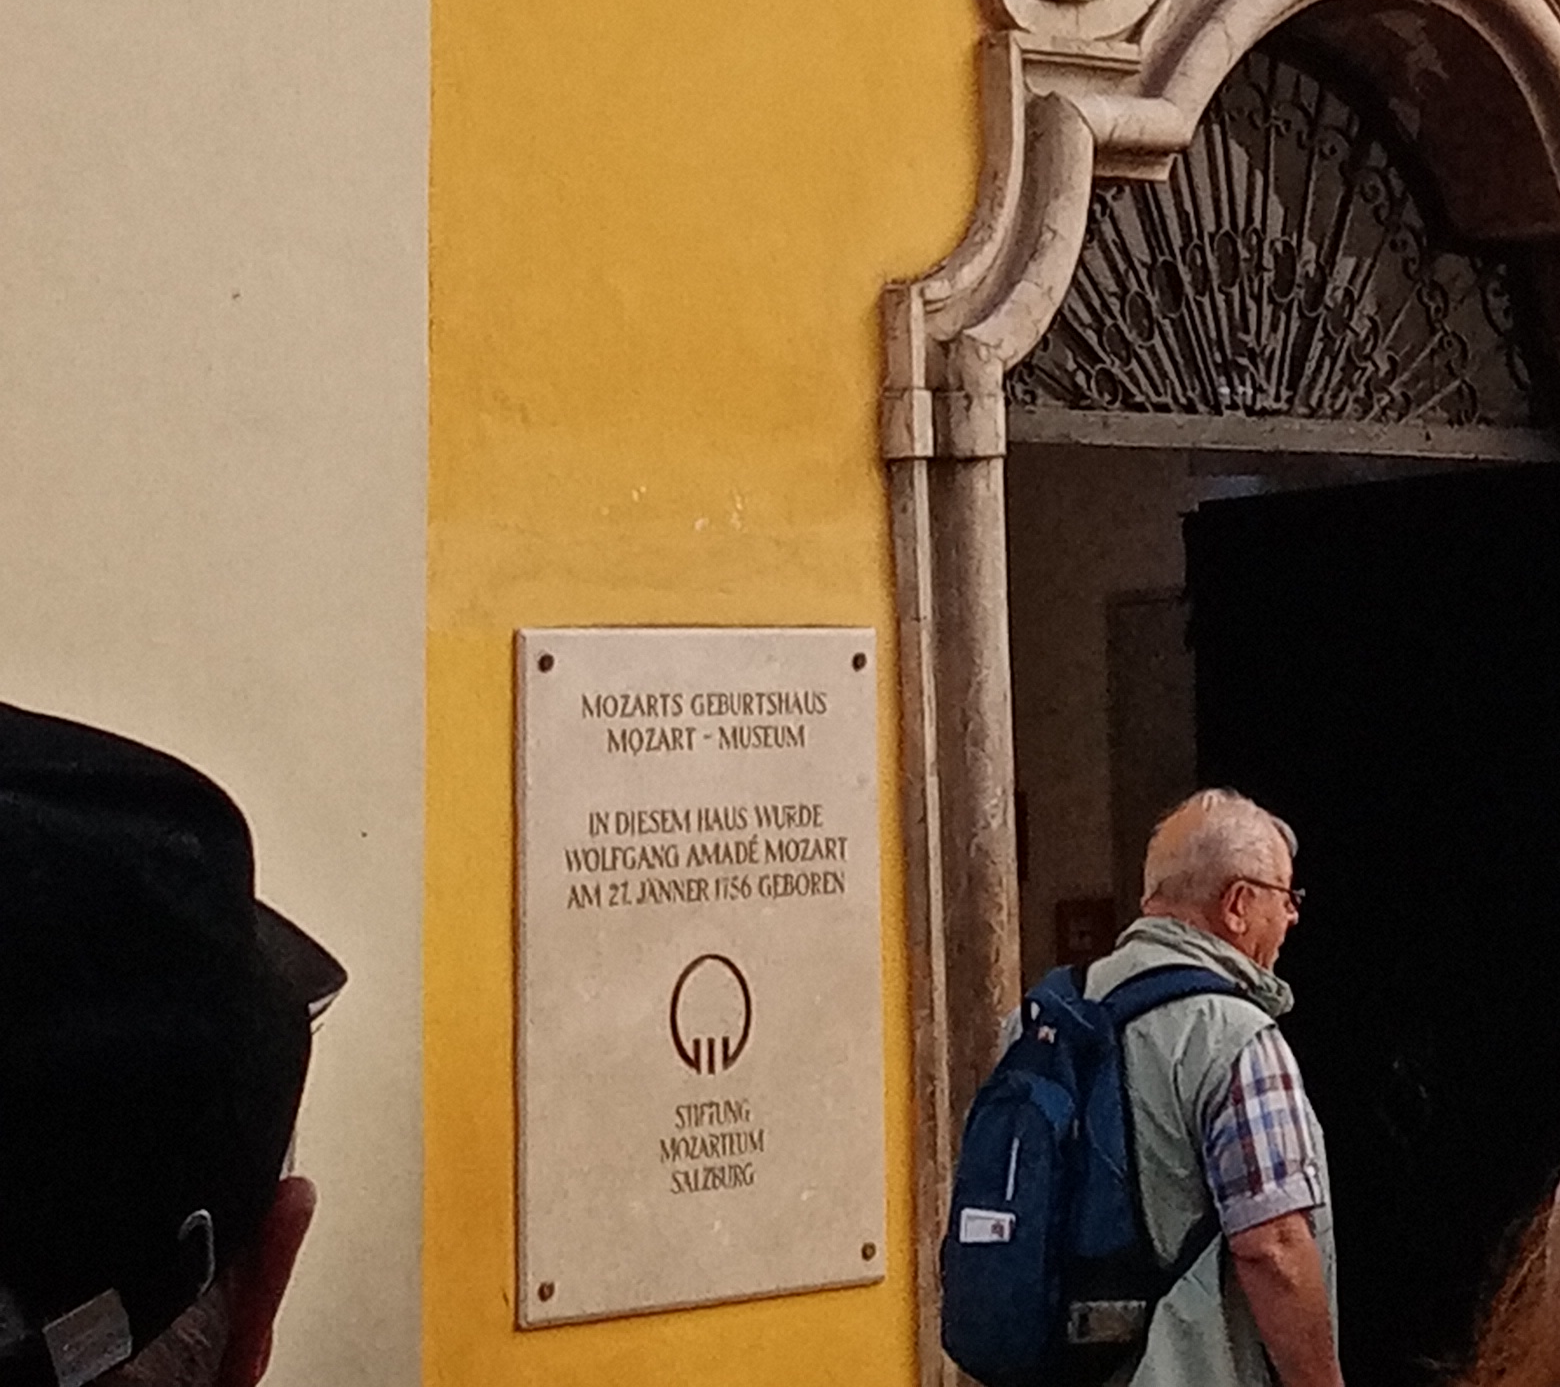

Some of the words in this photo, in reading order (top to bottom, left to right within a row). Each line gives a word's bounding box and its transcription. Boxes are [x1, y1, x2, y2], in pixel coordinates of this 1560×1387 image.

[581, 693, 683, 719] MOZARTS
[691, 691, 828, 716] GEBURTSHAUS
[607, 726, 696, 756] MOZART
[718, 725, 805, 750] MUSEUM
[588, 811, 610, 838] IN
[615, 808, 691, 836] DIESEM
[697, 806, 748, 833] HAUS
[754, 804, 823, 831] WURDE
[565, 844, 679, 873] WOLFGANG
[686, 834, 759, 868] AMADÉ
[764, 837, 848, 864] MOZART
[567, 883, 601, 909] AM
[715, 874, 752, 901] 1756
[758, 871, 845, 900] GEBOREN
[675, 1098, 750, 1129] STIFTUNG
[670, 1162, 755, 1195] SALZBURG
